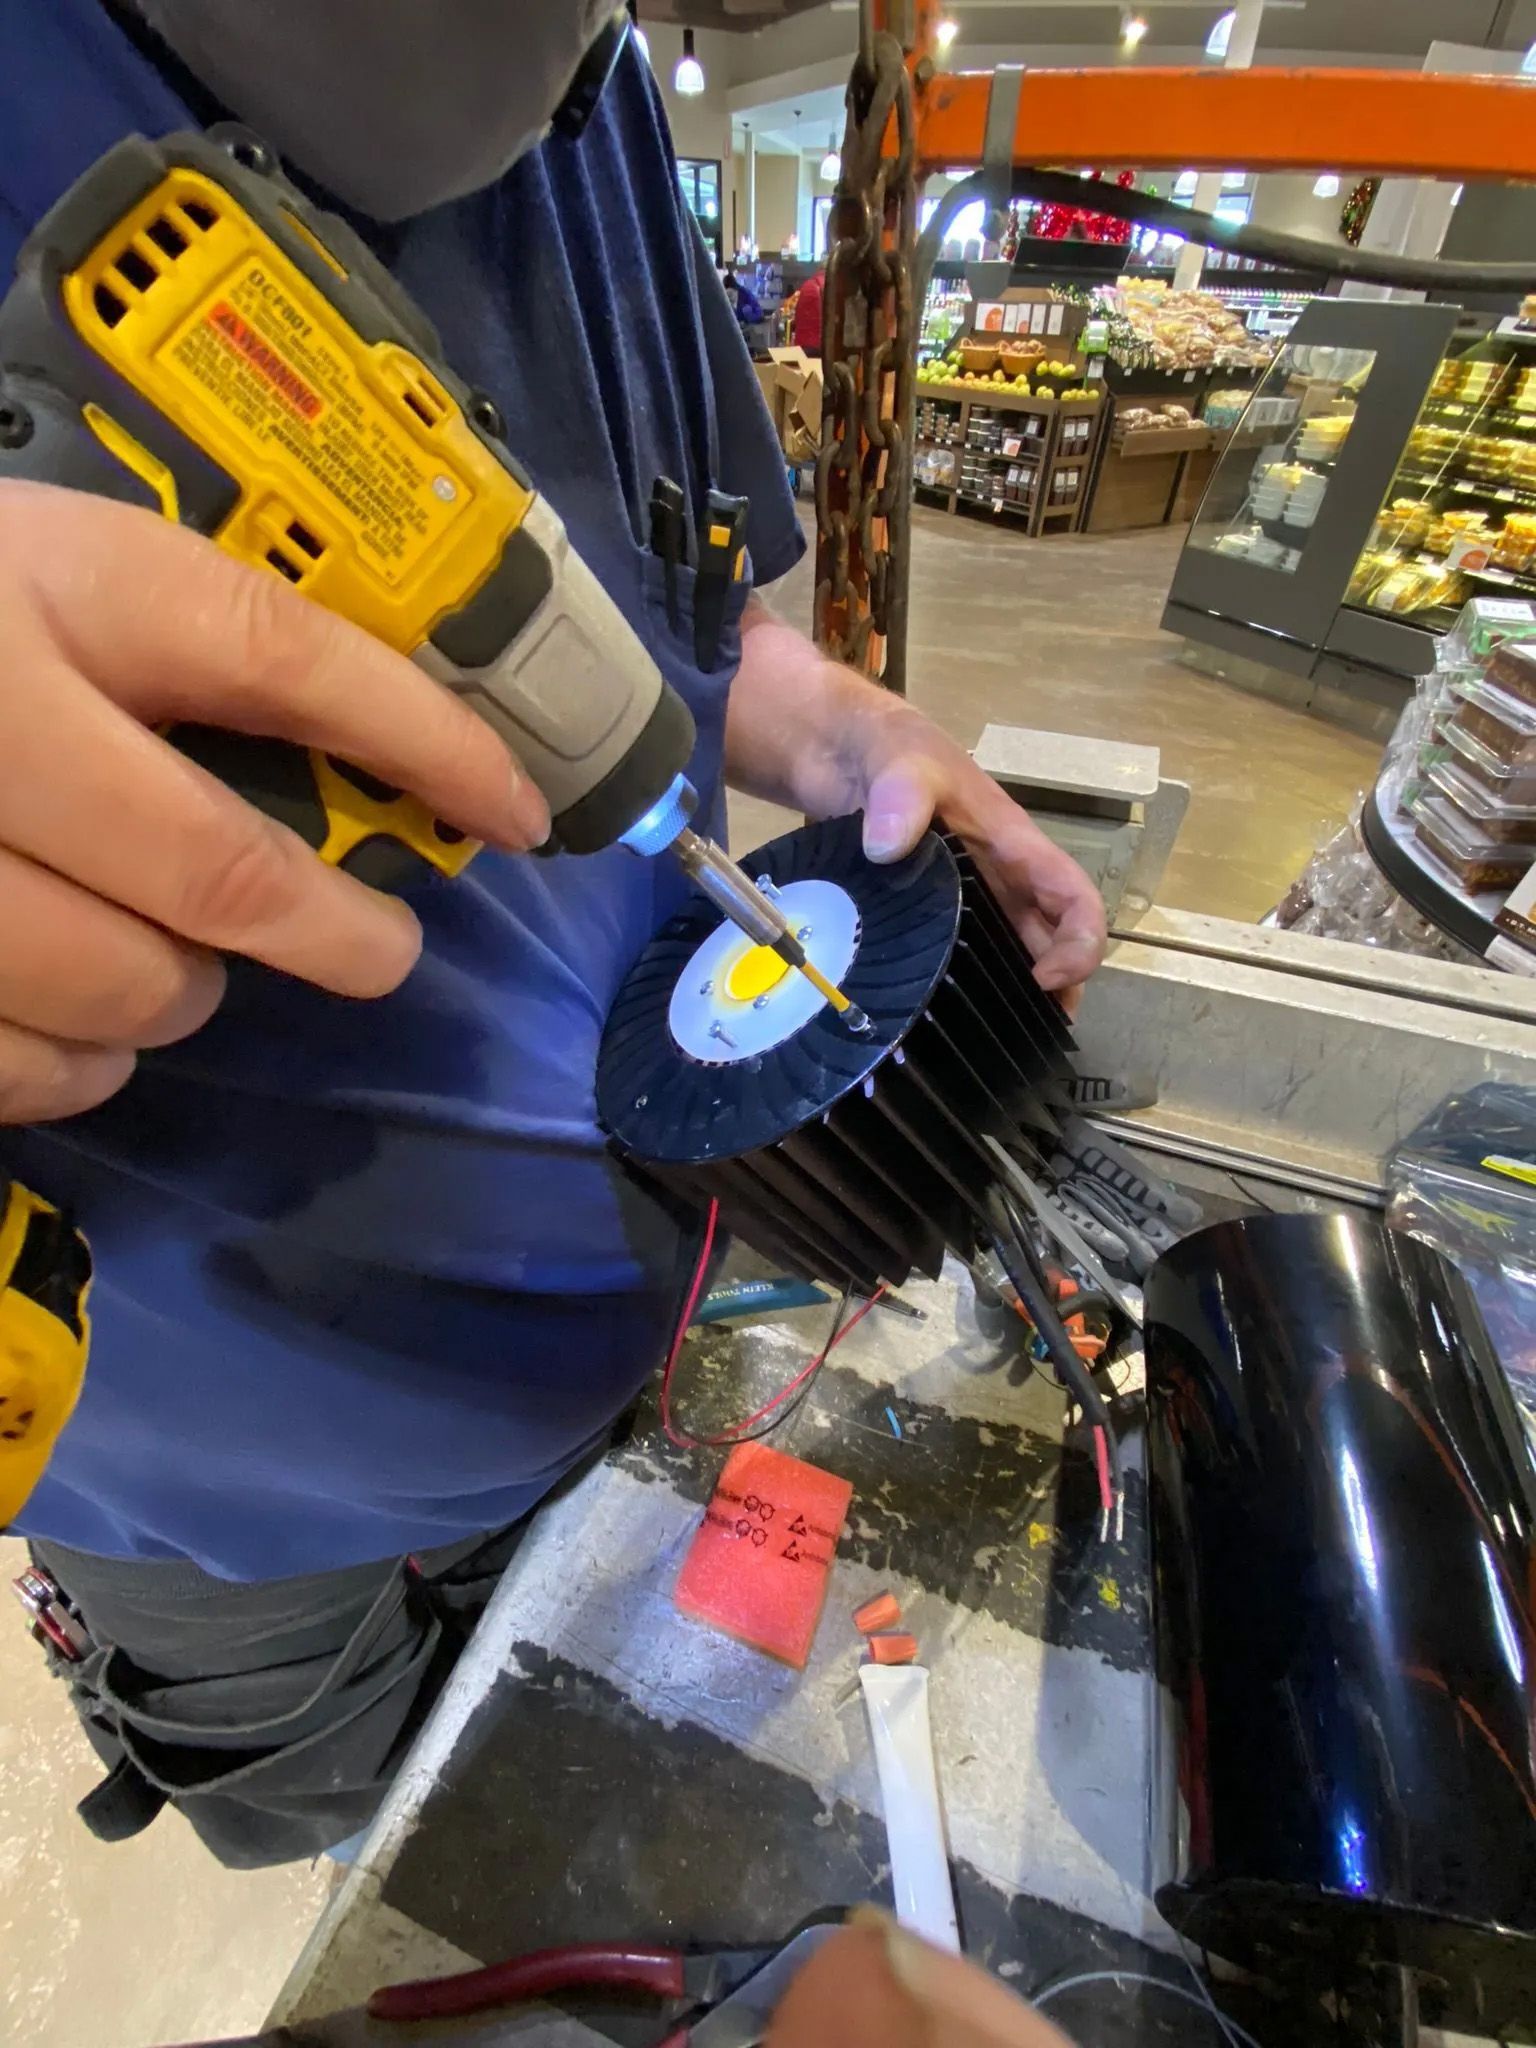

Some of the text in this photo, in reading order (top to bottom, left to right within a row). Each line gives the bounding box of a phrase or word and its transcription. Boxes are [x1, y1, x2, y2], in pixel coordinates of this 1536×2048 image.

[236, 329, 318, 413] WARNING
[706, 1283, 774, 1300] KLEIN TOOLS
